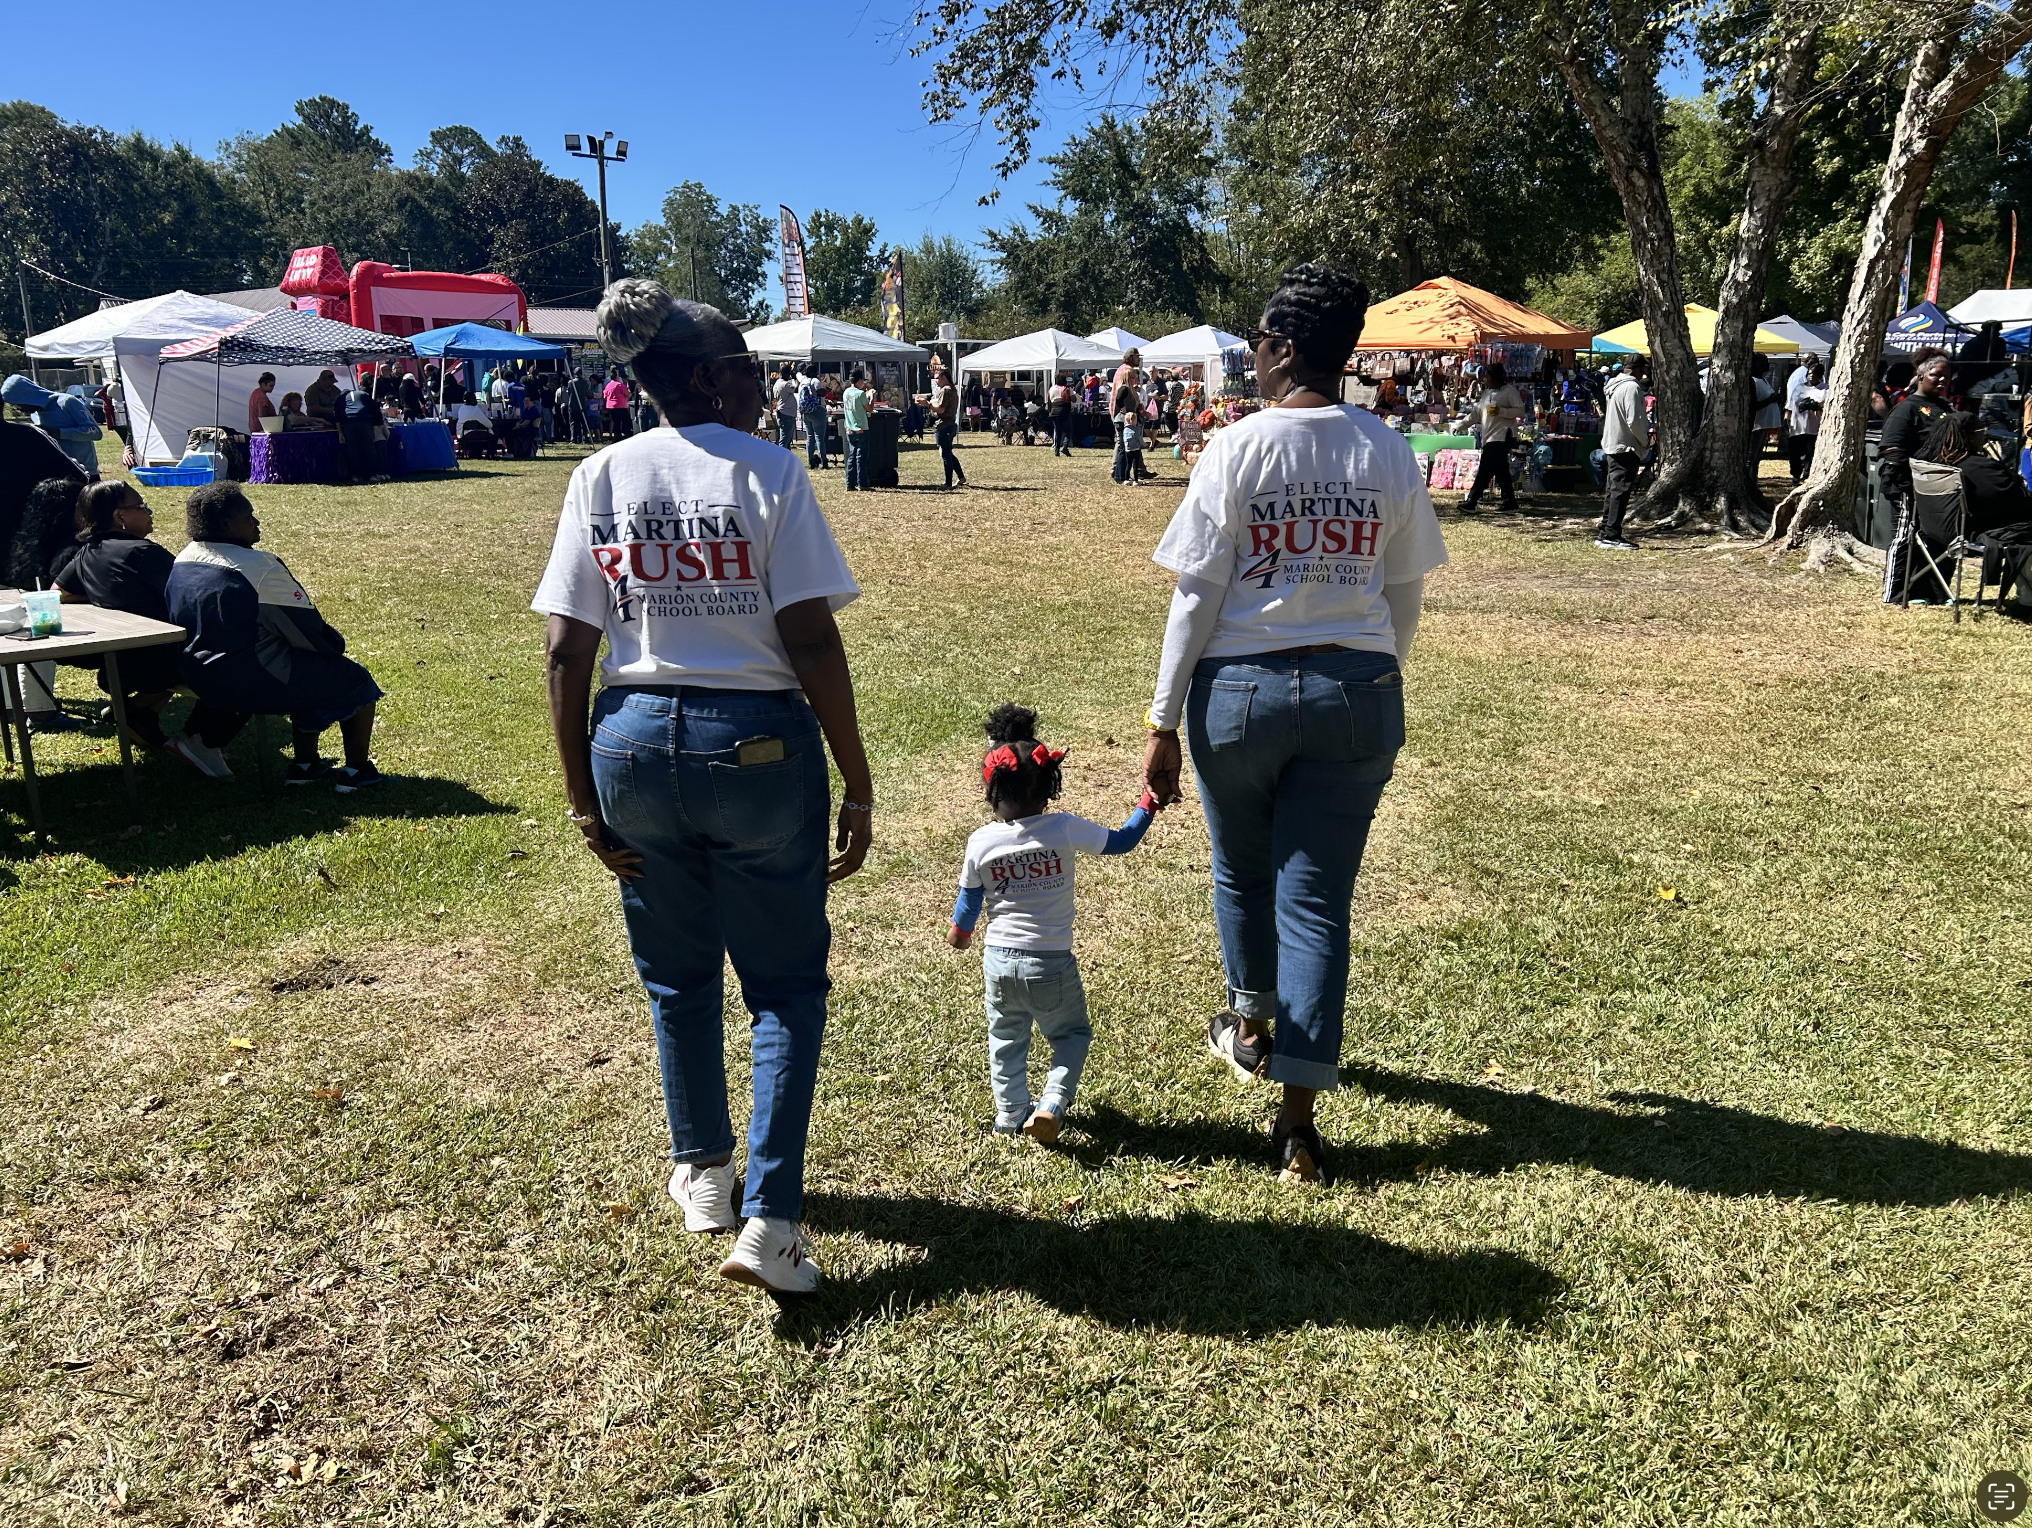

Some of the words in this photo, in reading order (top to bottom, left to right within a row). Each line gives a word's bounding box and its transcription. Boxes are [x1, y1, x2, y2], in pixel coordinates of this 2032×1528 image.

[1284, 481, 1352, 496] ELECT
[627, 500, 703, 515] ELECT
[1250, 497, 1380, 522] MARTINA
[590, 516, 744, 545] MARTINA
[1247, 518, 1384, 557] RUSH
[591, 541, 756, 584] RUSH
[1240, 547, 1282, 589] 4
[1283, 563, 1332, 574] MARION
[1285, 573, 1334, 585] SCHOOL
[637, 594, 695, 605] MARION
[700, 591, 760, 602] COUNTY
[707, 603, 759, 616] BOARD
[989, 857, 1063, 881] RUSH
[994, 877, 1010, 894] 4
[1039, 877, 1065, 886] COUNTY
